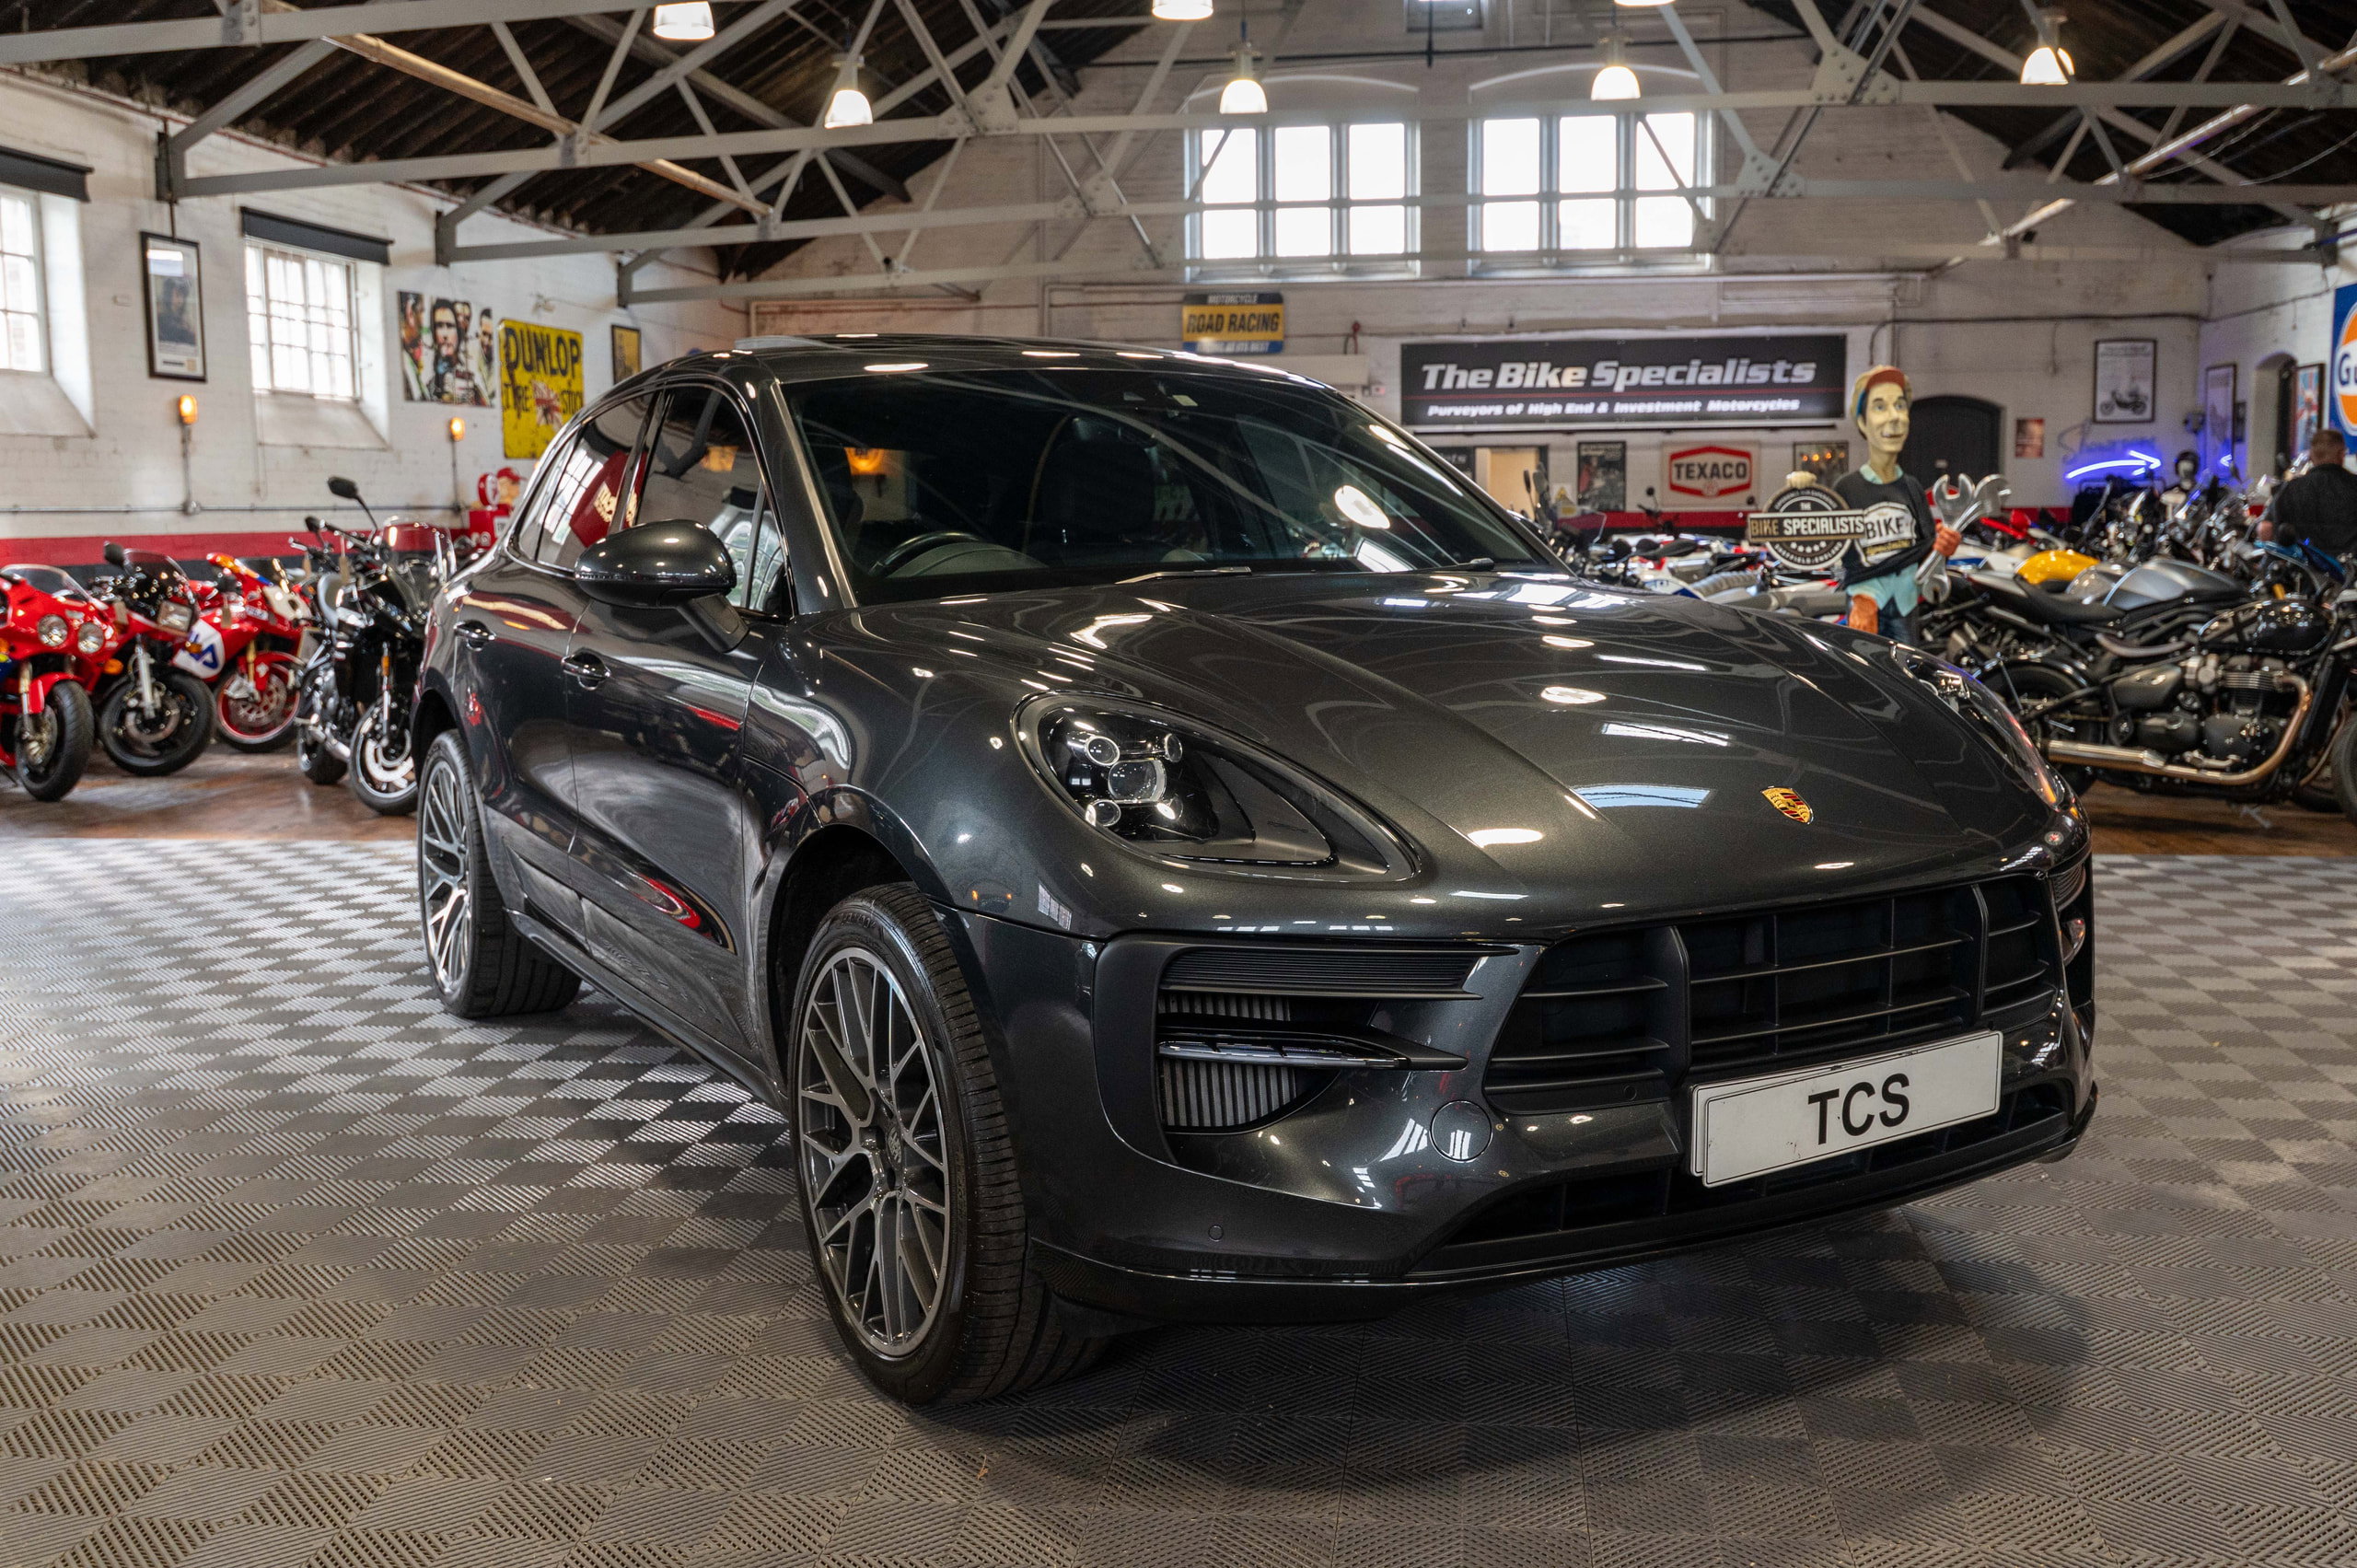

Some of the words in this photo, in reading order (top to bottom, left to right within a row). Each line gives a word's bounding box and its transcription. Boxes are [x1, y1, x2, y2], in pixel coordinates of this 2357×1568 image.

[1187, 314, 1225, 332] ROAD
[1227, 312, 1280, 331] RACING
[504, 327, 581, 379] DUNLOP
[1422, 364, 1493, 390] The
[1496, 361, 1587, 389] Bike
[1590, 357, 1817, 392] Specialists
[1427, 403, 1504, 418] Purveyors
[1505, 403, 1525, 416] of
[1527, 403, 1562, 417] High
[1564, 402, 1595, 414] End
[1596, 401, 1609, 414] &
[1613, 401, 1701, 413] Investment
[1706, 399, 1800, 412] Motorcycles
[1675, 462, 1747, 480] TEXACO
[1800, 502, 1812, 510] THE
[1750, 518, 1779, 536] BIKE
[1782, 516, 1864, 536] SPECIALISTS
[1864, 516, 1905, 540] BIKE
[1807, 1073, 1910, 1145] TCS
